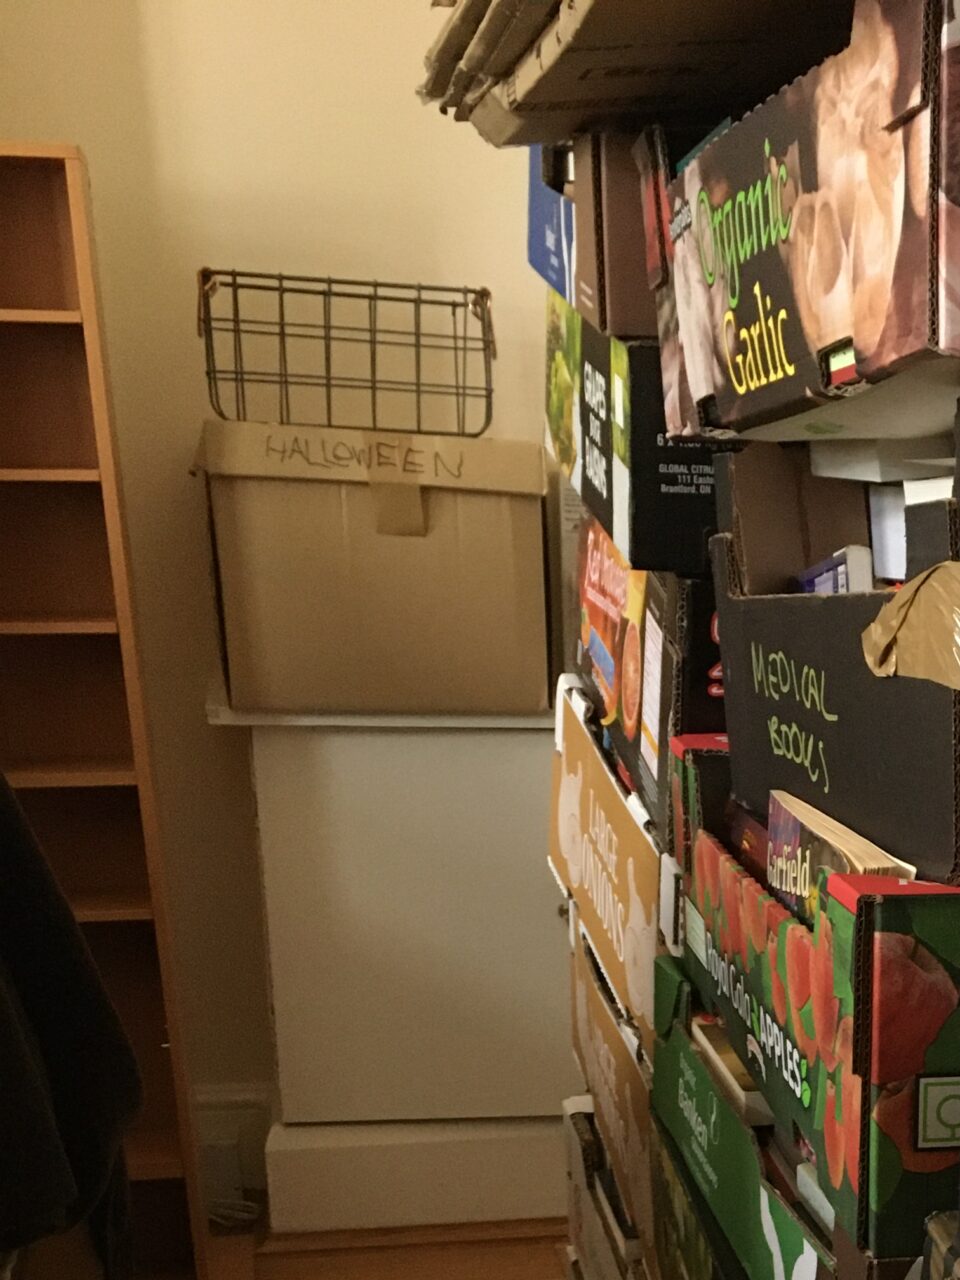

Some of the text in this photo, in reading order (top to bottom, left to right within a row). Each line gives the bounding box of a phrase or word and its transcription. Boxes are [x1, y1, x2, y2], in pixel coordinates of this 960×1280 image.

[698, 137, 791, 309] Organic
[724, 281, 795, 395] Garlic
[266, 435, 464, 479] HALLOWEEN
[751, 641, 838, 721] MEDICAL
[767, 841, 810, 899] Garfield
